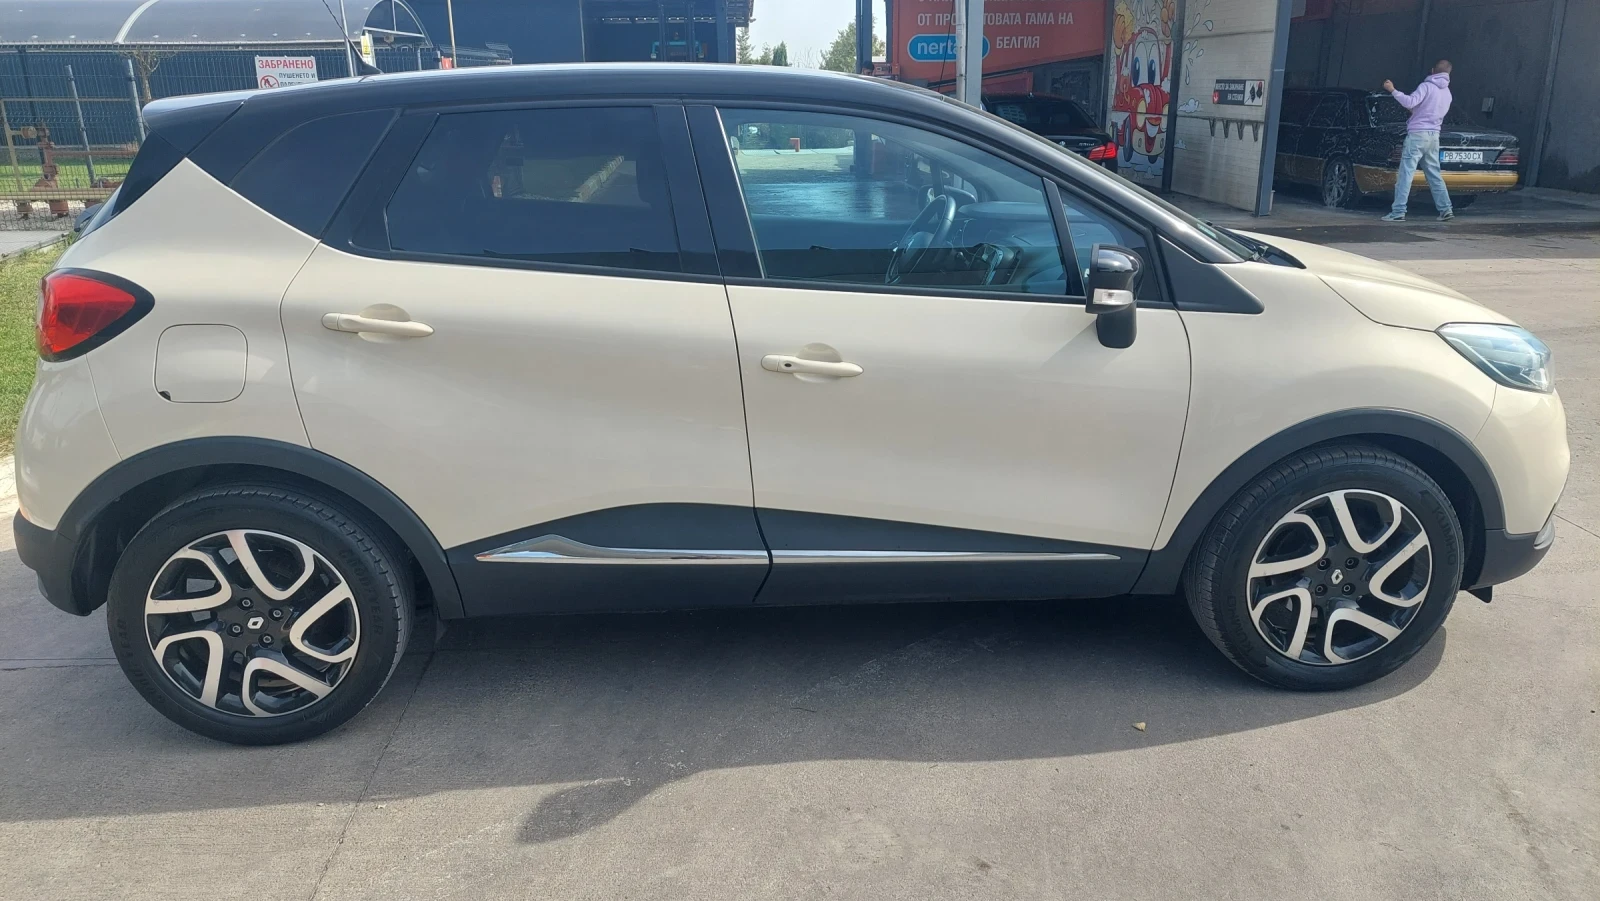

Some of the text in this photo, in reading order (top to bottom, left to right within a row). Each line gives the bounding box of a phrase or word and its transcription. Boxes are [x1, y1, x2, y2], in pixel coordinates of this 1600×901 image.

[917, 12, 1074, 26] ОТ ПРОТОВАТА ГАМА НА
[996, 36, 1040, 49] БЕЛГИЯ
[258, 59, 314, 69] ЗАБРАНЕНО
[1454, 152, 1471, 160] 7530
[1432, 505, 1457, 566] KUMHO
